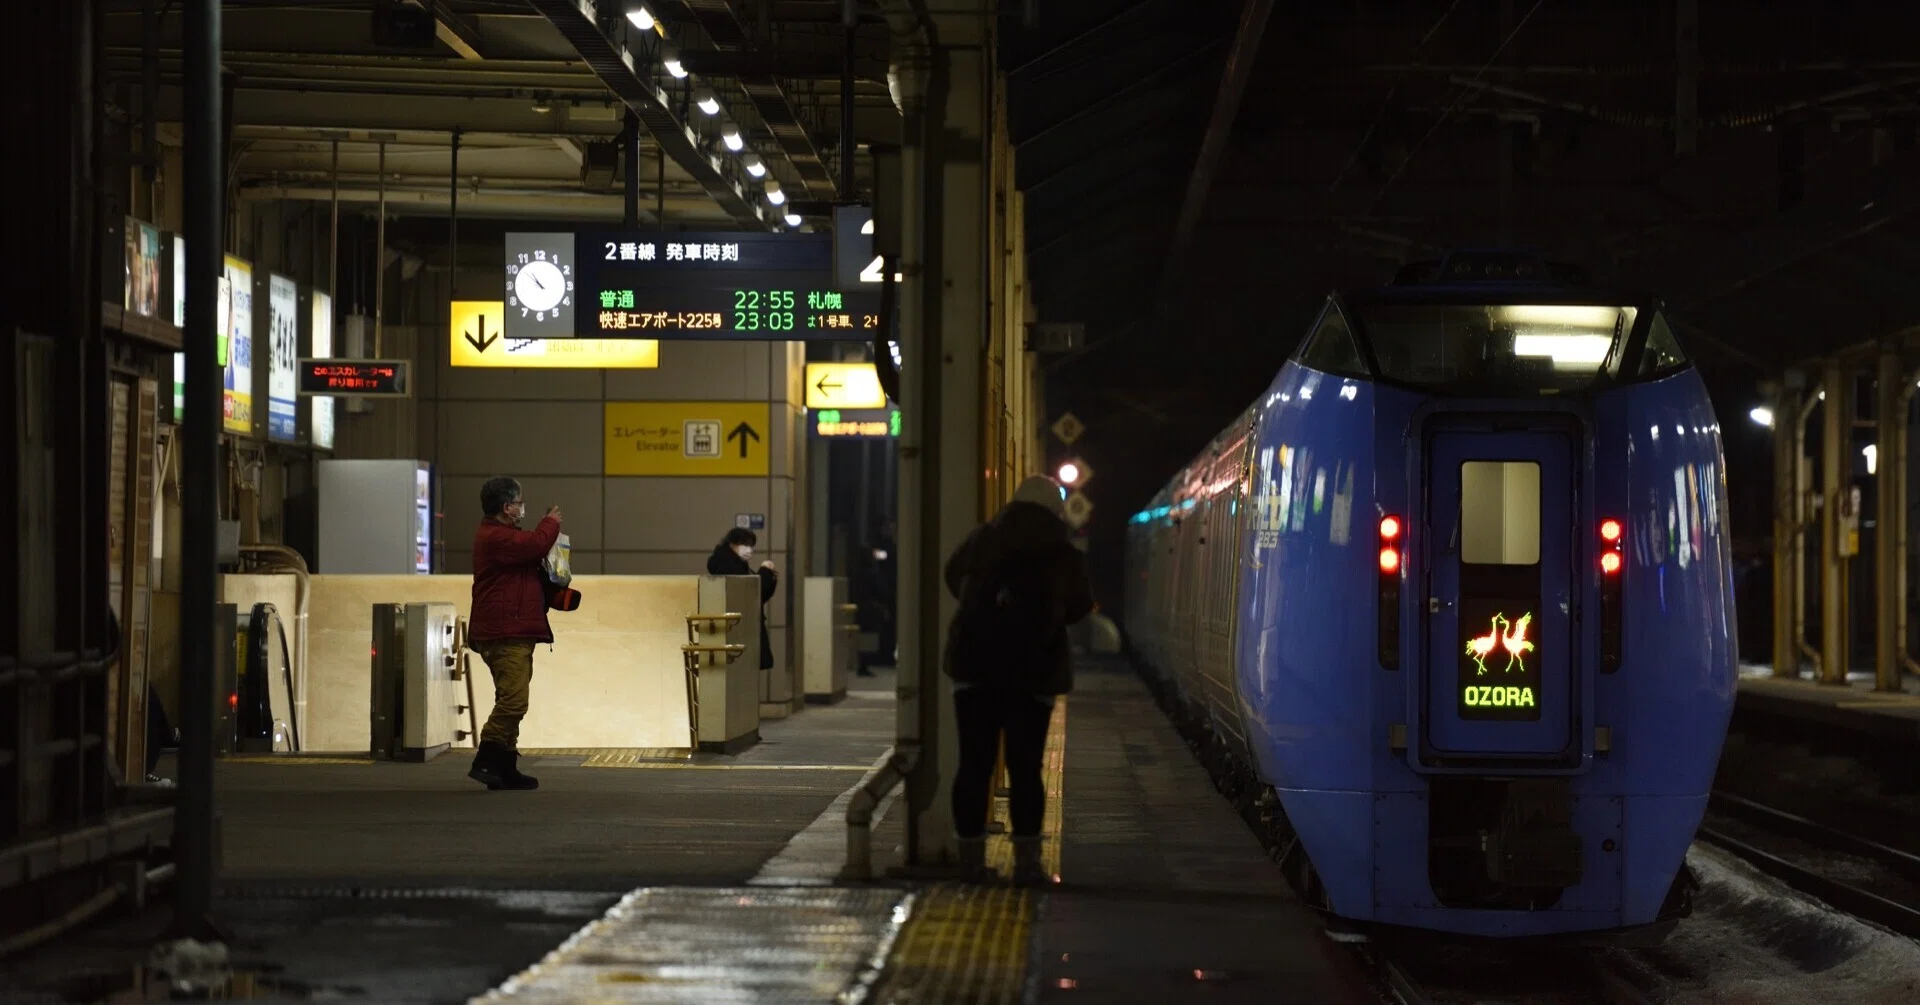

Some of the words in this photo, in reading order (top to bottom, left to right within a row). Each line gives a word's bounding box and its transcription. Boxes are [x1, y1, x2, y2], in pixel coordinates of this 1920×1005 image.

[534, 249, 546, 261] 12
[605, 242, 656, 261] 2番線
[666, 243, 739, 261] 発車時刻
[518, 253, 529, 264] 11
[552, 254, 558, 265] 1
[506, 264, 519, 275] 10
[563, 264, 570, 276] 2
[506, 281, 514, 291] 9
[566, 281, 574, 292] 3
[509, 296, 517, 307] 8
[562, 296, 570, 307] 4
[600, 290, 634, 308] 普通
[734, 291, 795, 309] 22:55
[807, 291, 842, 309] 札幌
[521, 307, 529, 318] 7
[536, 311, 544, 322] 6
[552, 307, 559, 318] 5
[600, 311, 722, 329] 快速エアポート225号
[734, 312, 794, 330] 23:03
[1465, 686, 1534, 706] OZORA
